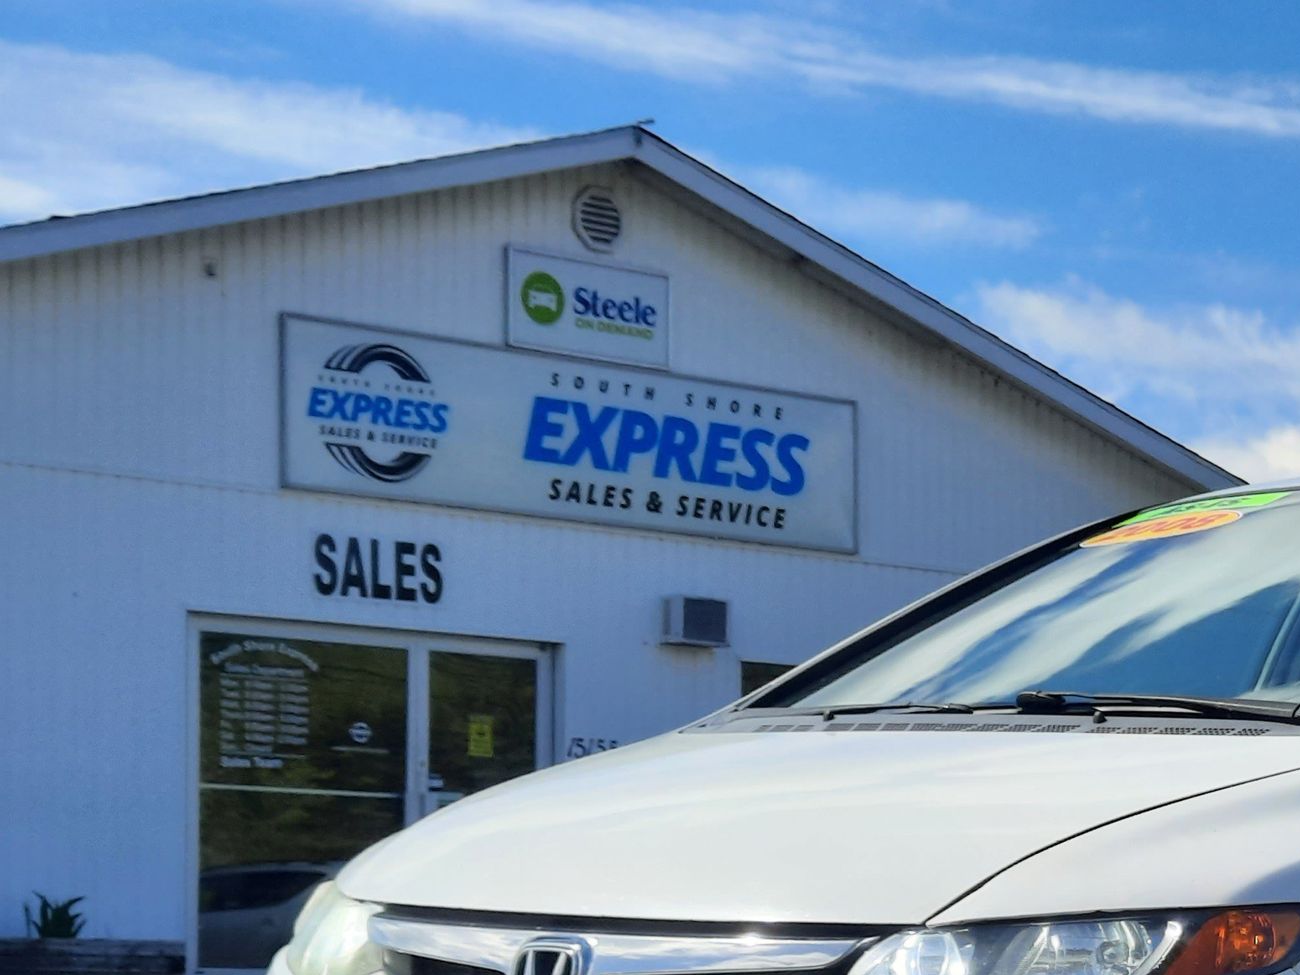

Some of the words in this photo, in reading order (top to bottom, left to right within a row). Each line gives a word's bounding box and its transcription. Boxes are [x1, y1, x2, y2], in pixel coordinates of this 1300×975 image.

[573, 286, 657, 327] Steele
[307, 387, 448, 433] EXPRESS
[551, 373, 655, 400] SOUTH
[685, 393, 784, 420] SHORE
[319, 424, 360, 440] SALES
[382, 432, 438, 449] SERVICE
[523, 396, 810, 496] EXPRESS
[549, 478, 633, 510] SALES
[646, 491, 662, 514] &
[676, 496, 787, 530] SERVICE
[313, 533, 443, 604] SALES
